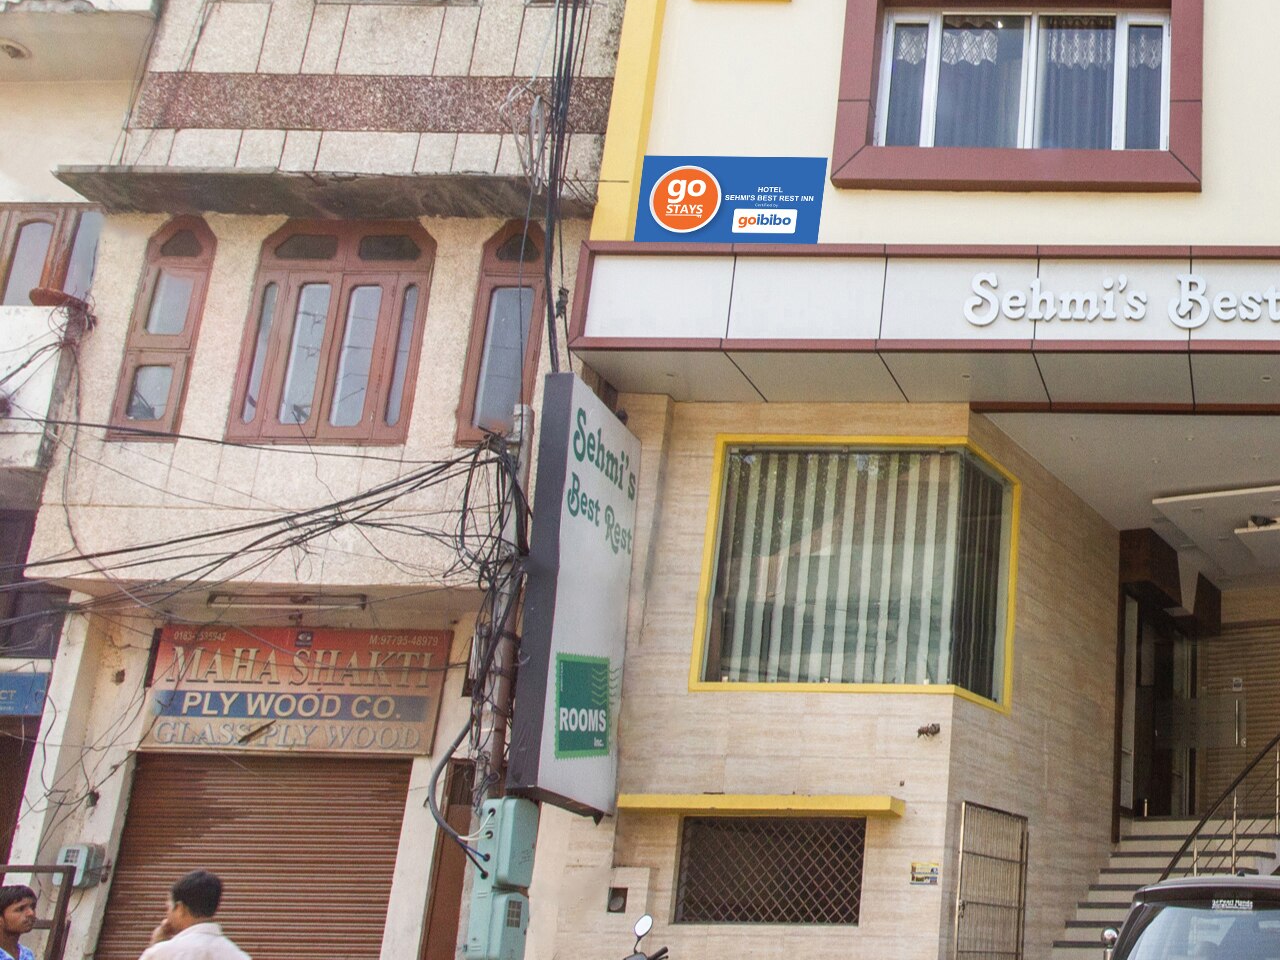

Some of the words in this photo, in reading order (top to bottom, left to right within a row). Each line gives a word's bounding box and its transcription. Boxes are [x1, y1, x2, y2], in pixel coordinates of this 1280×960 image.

[667, 178, 707, 204] go
[665, 204, 703, 215] STAYS
[738, 213, 792, 228] goibibo
[963, 271, 1148, 328] Sehmi's
[573, 407, 637, 501] Sehmi's
[566, 471, 601, 527] Best
[604, 504, 633, 555] Rest
[166, 645, 284, 685] MAHA
[288, 648, 435, 688] SHAKTI
[182, 693, 241, 716] PLY
[246, 694, 342, 718] WOOD
[351, 696, 401, 719] CO.
[559, 707, 607, 733] ROOMS
[153, 721, 251, 745] GLASS
[262, 723, 317, 747] PLY
[323, 725, 422, 750] WOOD
[593, 737, 604, 747] Inc.
